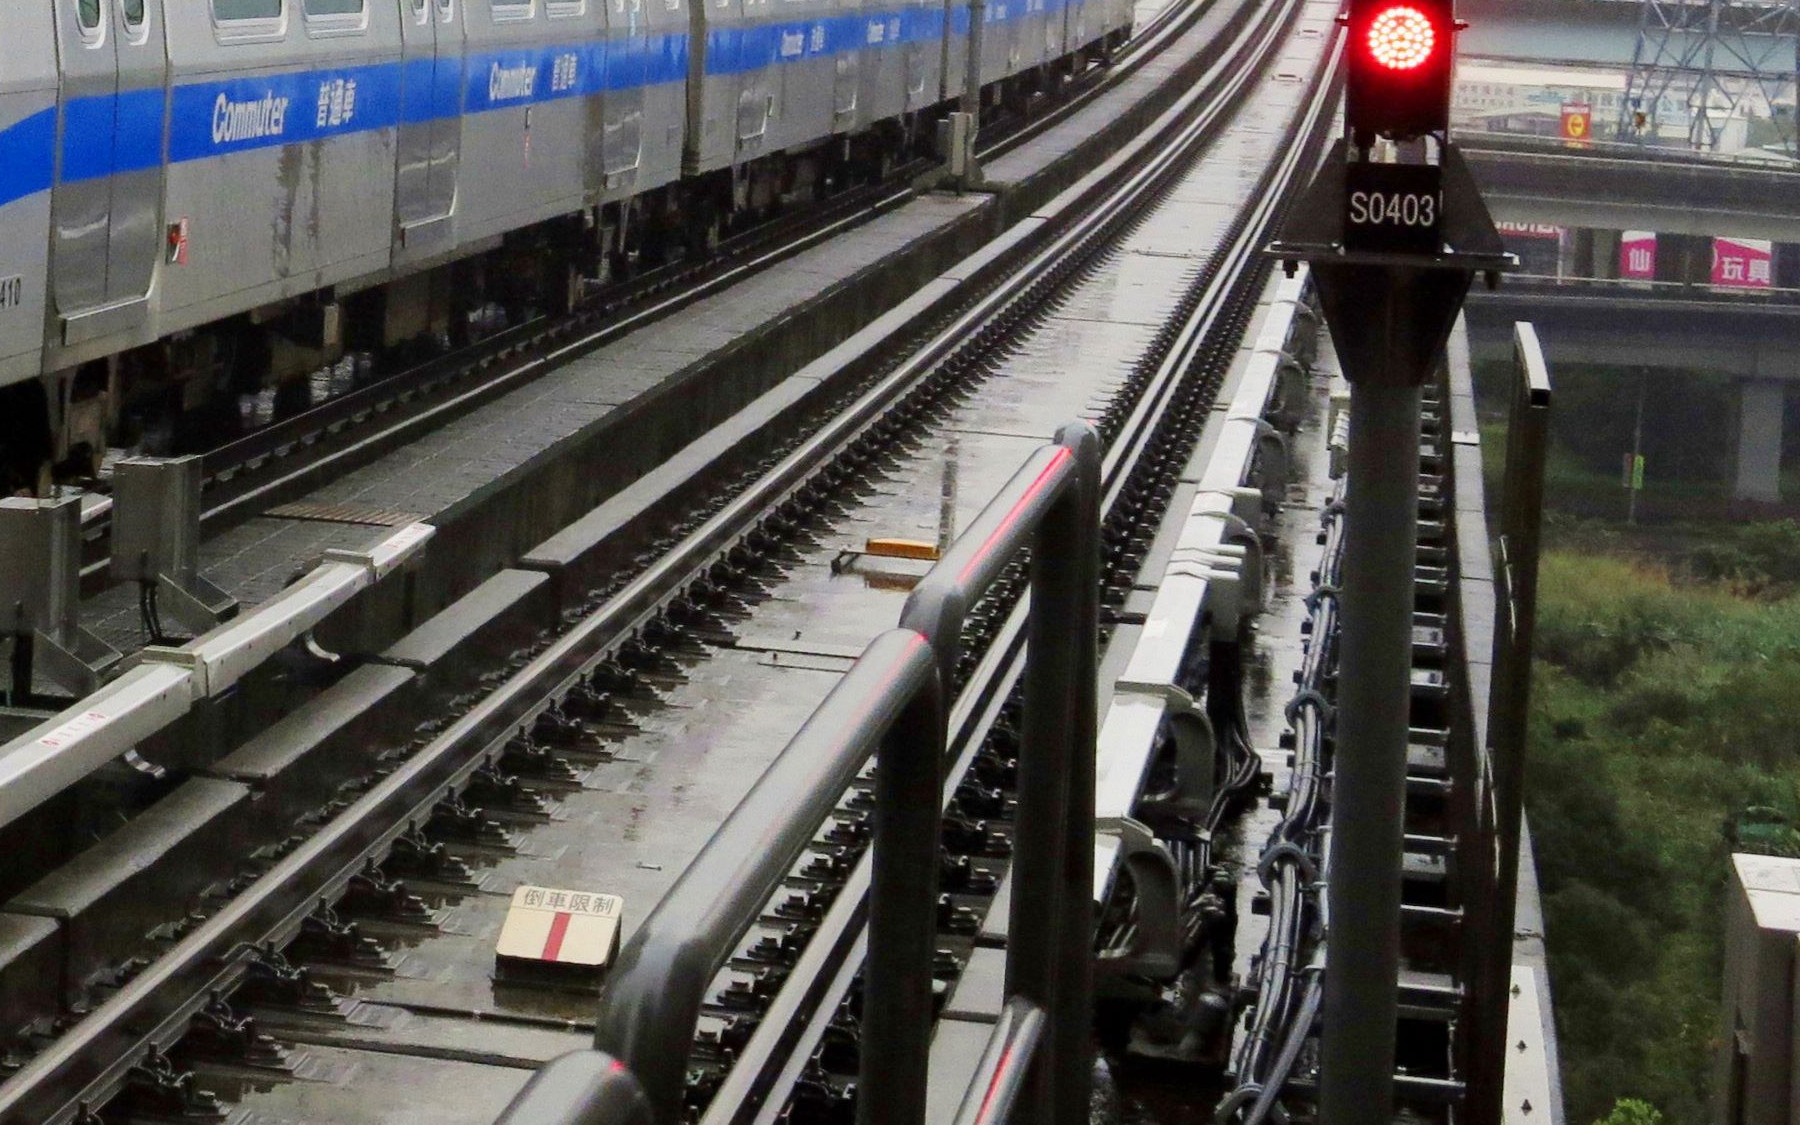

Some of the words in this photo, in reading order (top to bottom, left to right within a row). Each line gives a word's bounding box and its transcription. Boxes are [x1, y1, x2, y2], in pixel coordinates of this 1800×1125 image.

[489, 60, 537, 101] Commuter
[212, 92, 290, 144] Commuter
[316, 79, 358, 127] 普通車
[1349, 191, 1435, 228] S0403
[523, 889, 616, 915] 倒車限制
